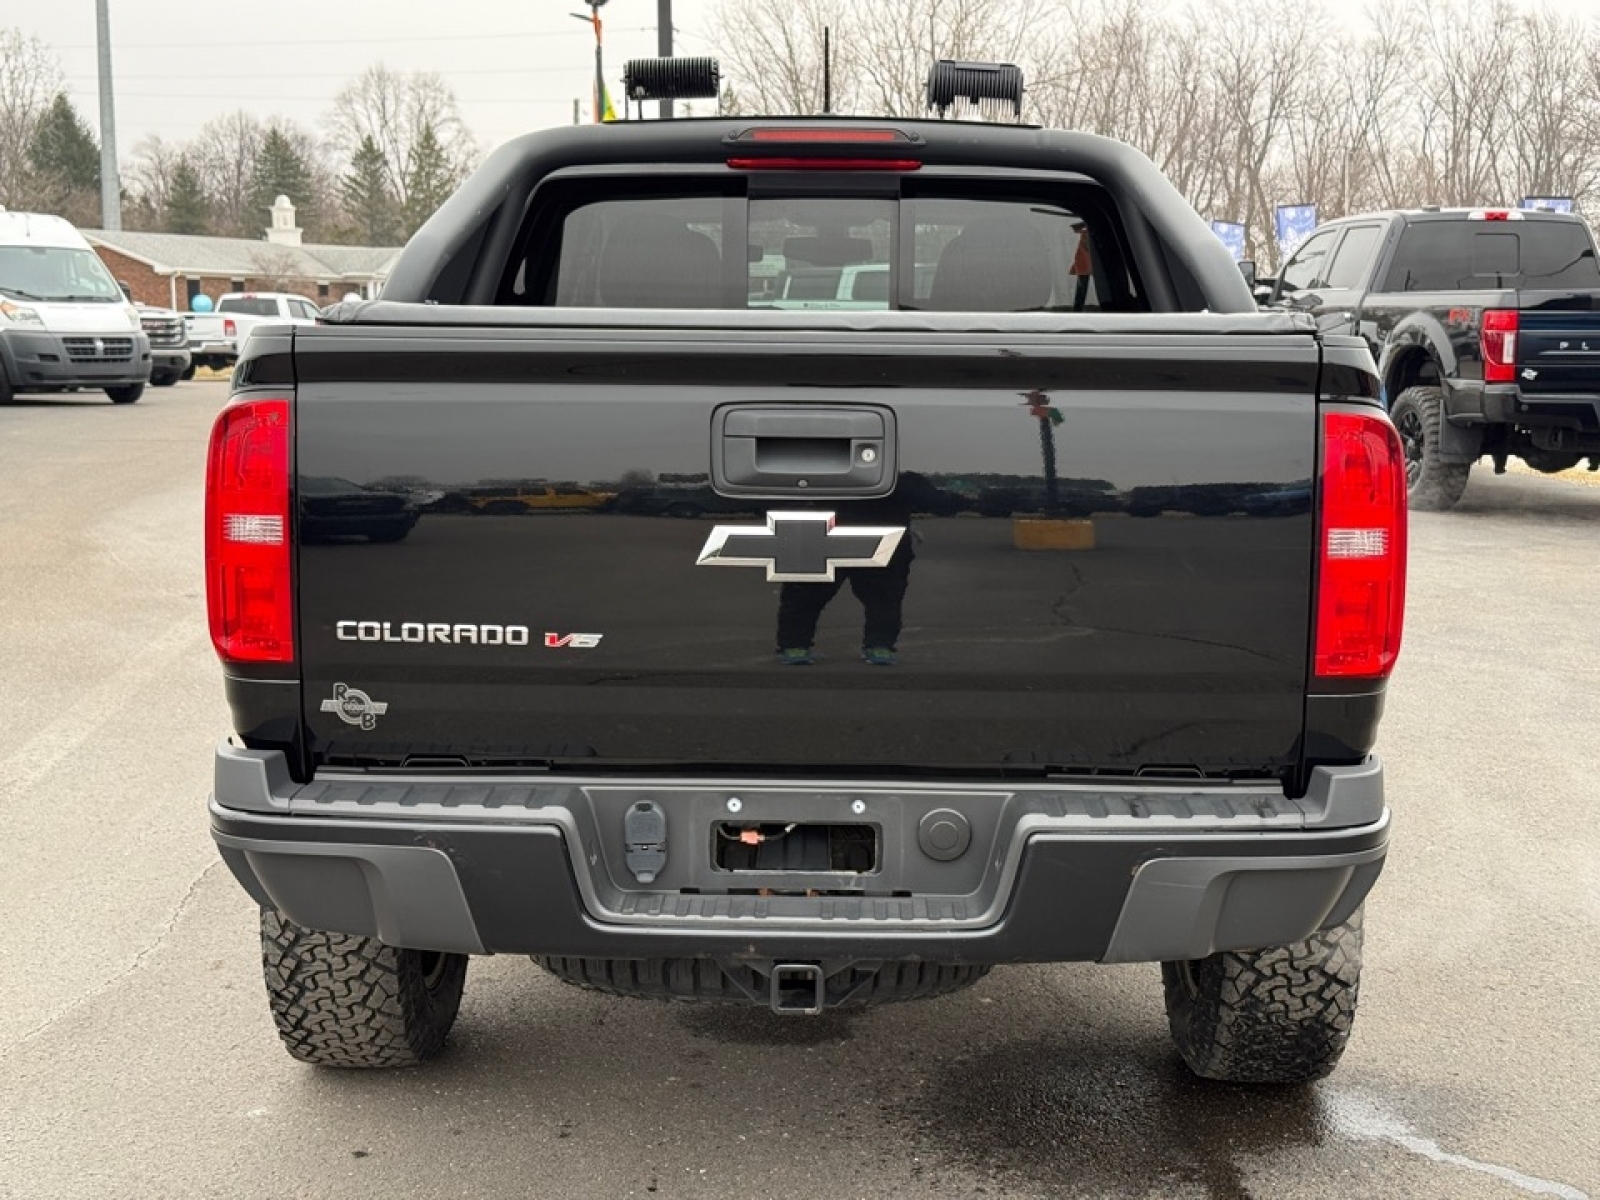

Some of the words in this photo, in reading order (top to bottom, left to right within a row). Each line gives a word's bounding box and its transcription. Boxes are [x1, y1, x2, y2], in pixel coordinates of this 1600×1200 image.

[336, 620, 529, 646] COLORADO
[544, 632, 603, 648] V6
[362, 713, 375, 729] B
